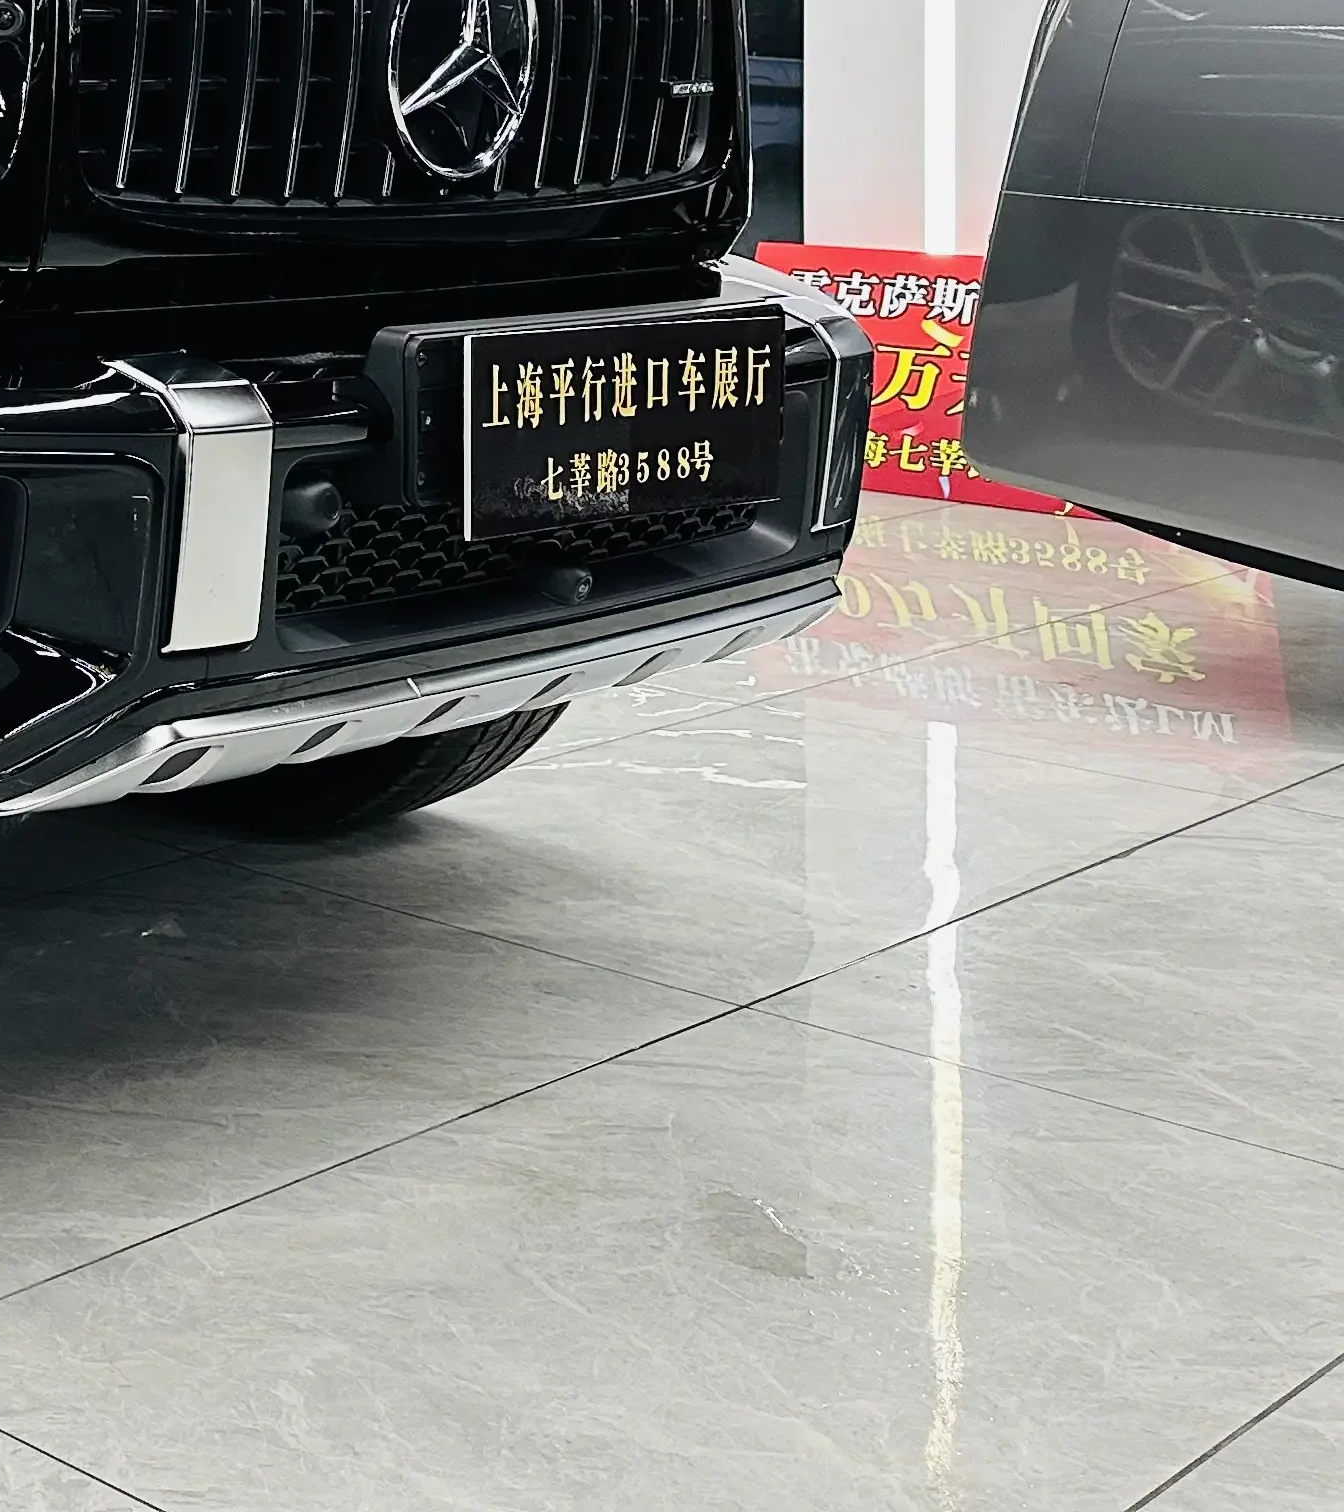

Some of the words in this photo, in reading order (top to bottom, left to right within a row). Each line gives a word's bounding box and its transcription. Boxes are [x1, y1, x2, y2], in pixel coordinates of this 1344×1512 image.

[482, 344, 771, 429] 上海平行进口车展厅
[541, 439, 714, 501] 七莘路3588号
